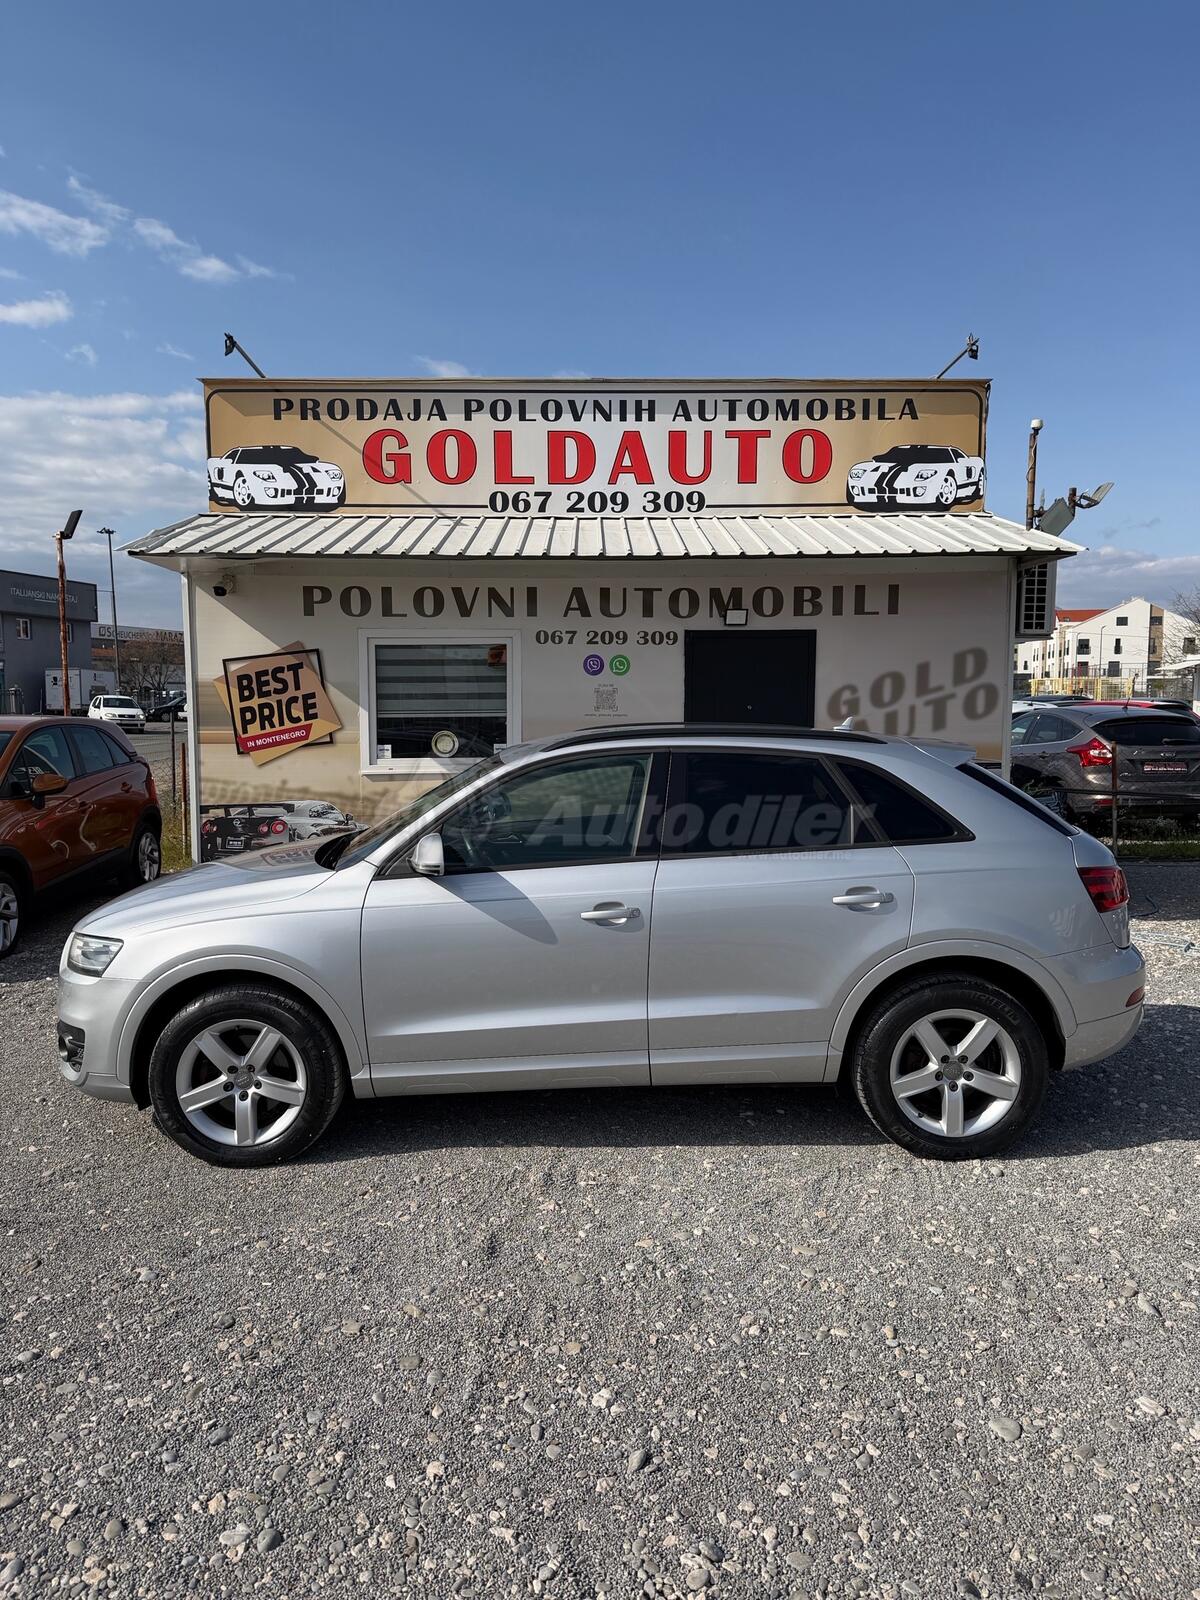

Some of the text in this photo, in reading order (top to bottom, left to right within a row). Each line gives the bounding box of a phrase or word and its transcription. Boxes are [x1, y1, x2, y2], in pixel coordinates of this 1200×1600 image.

[273, 397, 919, 423] PRODAJA POLOVNIH AUTOMOBILA
[362, 428, 833, 485] GOLDAUTO
[488, 490, 706, 514] 067 209 309
[302, 584, 900, 619] POLOVNI AUTOMOBILI
[535, 630, 679, 646] 067 209 309
[236, 661, 304, 703] BEST
[827, 646, 989, 722] GOLD
[239, 692, 319, 735] PRICE
[256, 729, 307, 747] MONTENEGRO
